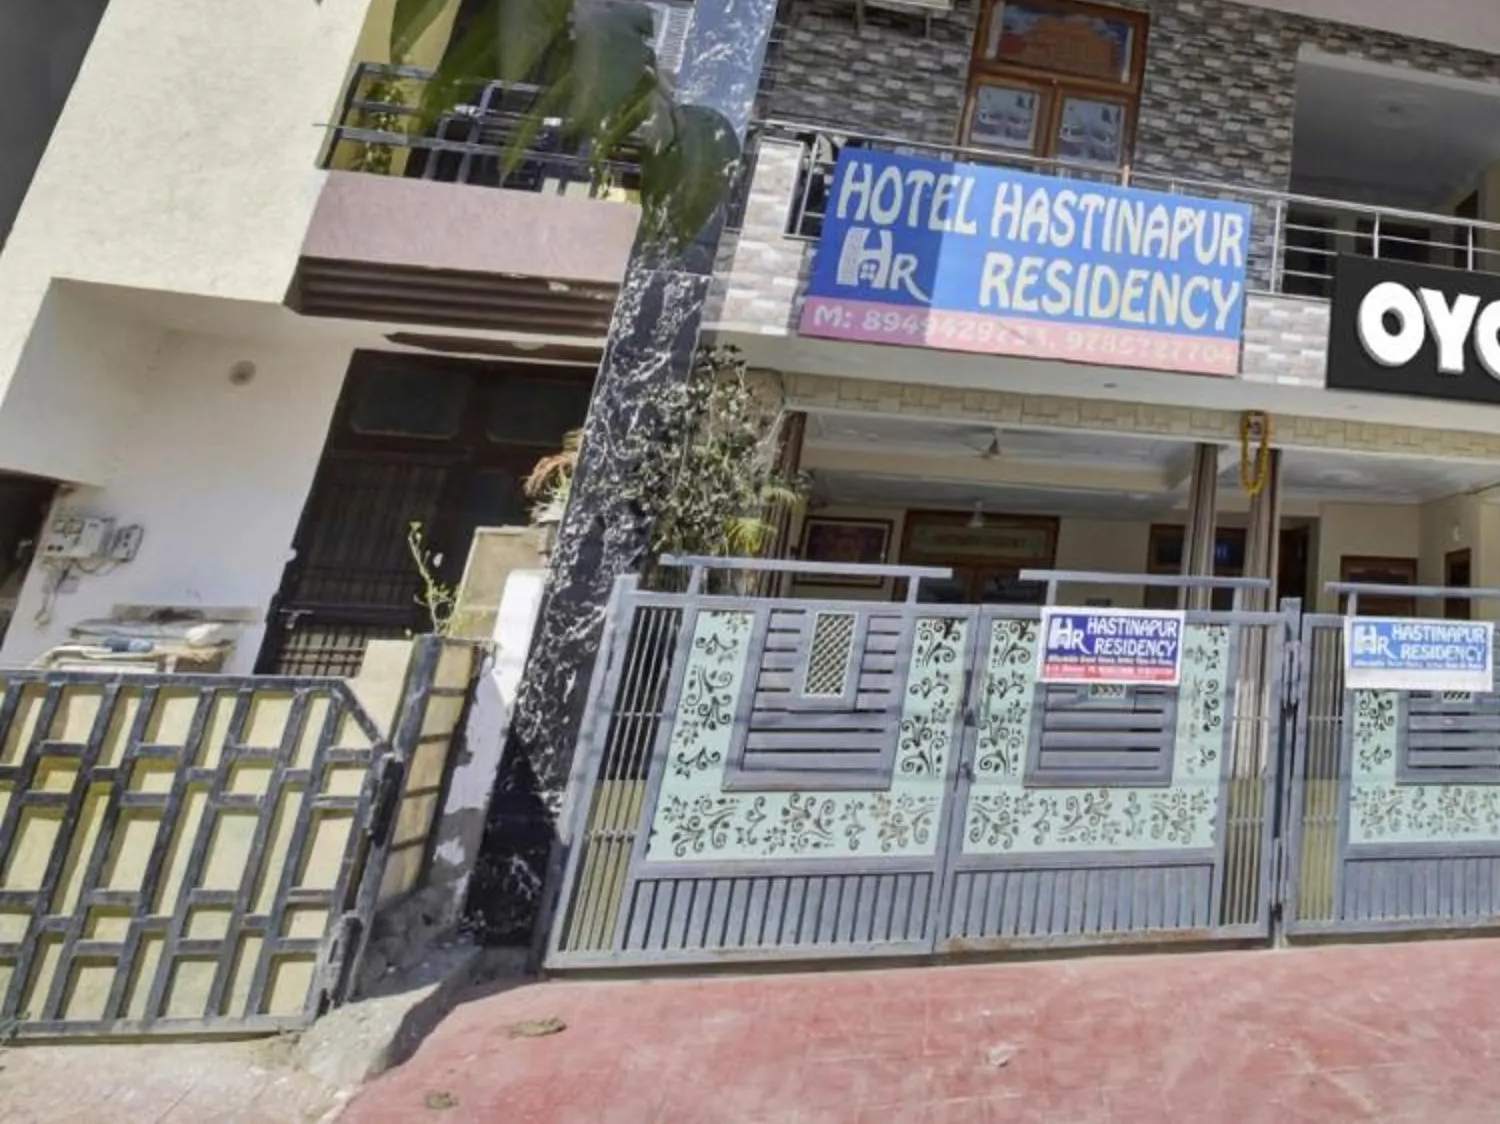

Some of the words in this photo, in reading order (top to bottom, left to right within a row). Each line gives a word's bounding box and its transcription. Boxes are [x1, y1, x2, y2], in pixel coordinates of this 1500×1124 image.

[837, 161, 977, 236] HOTEL
[990, 182, 1245, 268] HASTINAPUR
[979, 251, 1240, 332] RESIDENCY
[812, 305, 852, 330] M:
[1087, 617, 1178, 638] HASTINAPUR
[1391, 623, 1486, 643] HASTINAPUR
[1094, 637, 1177, 657] RESIDENCY
[1399, 642, 1484, 663] RESIDENCY
